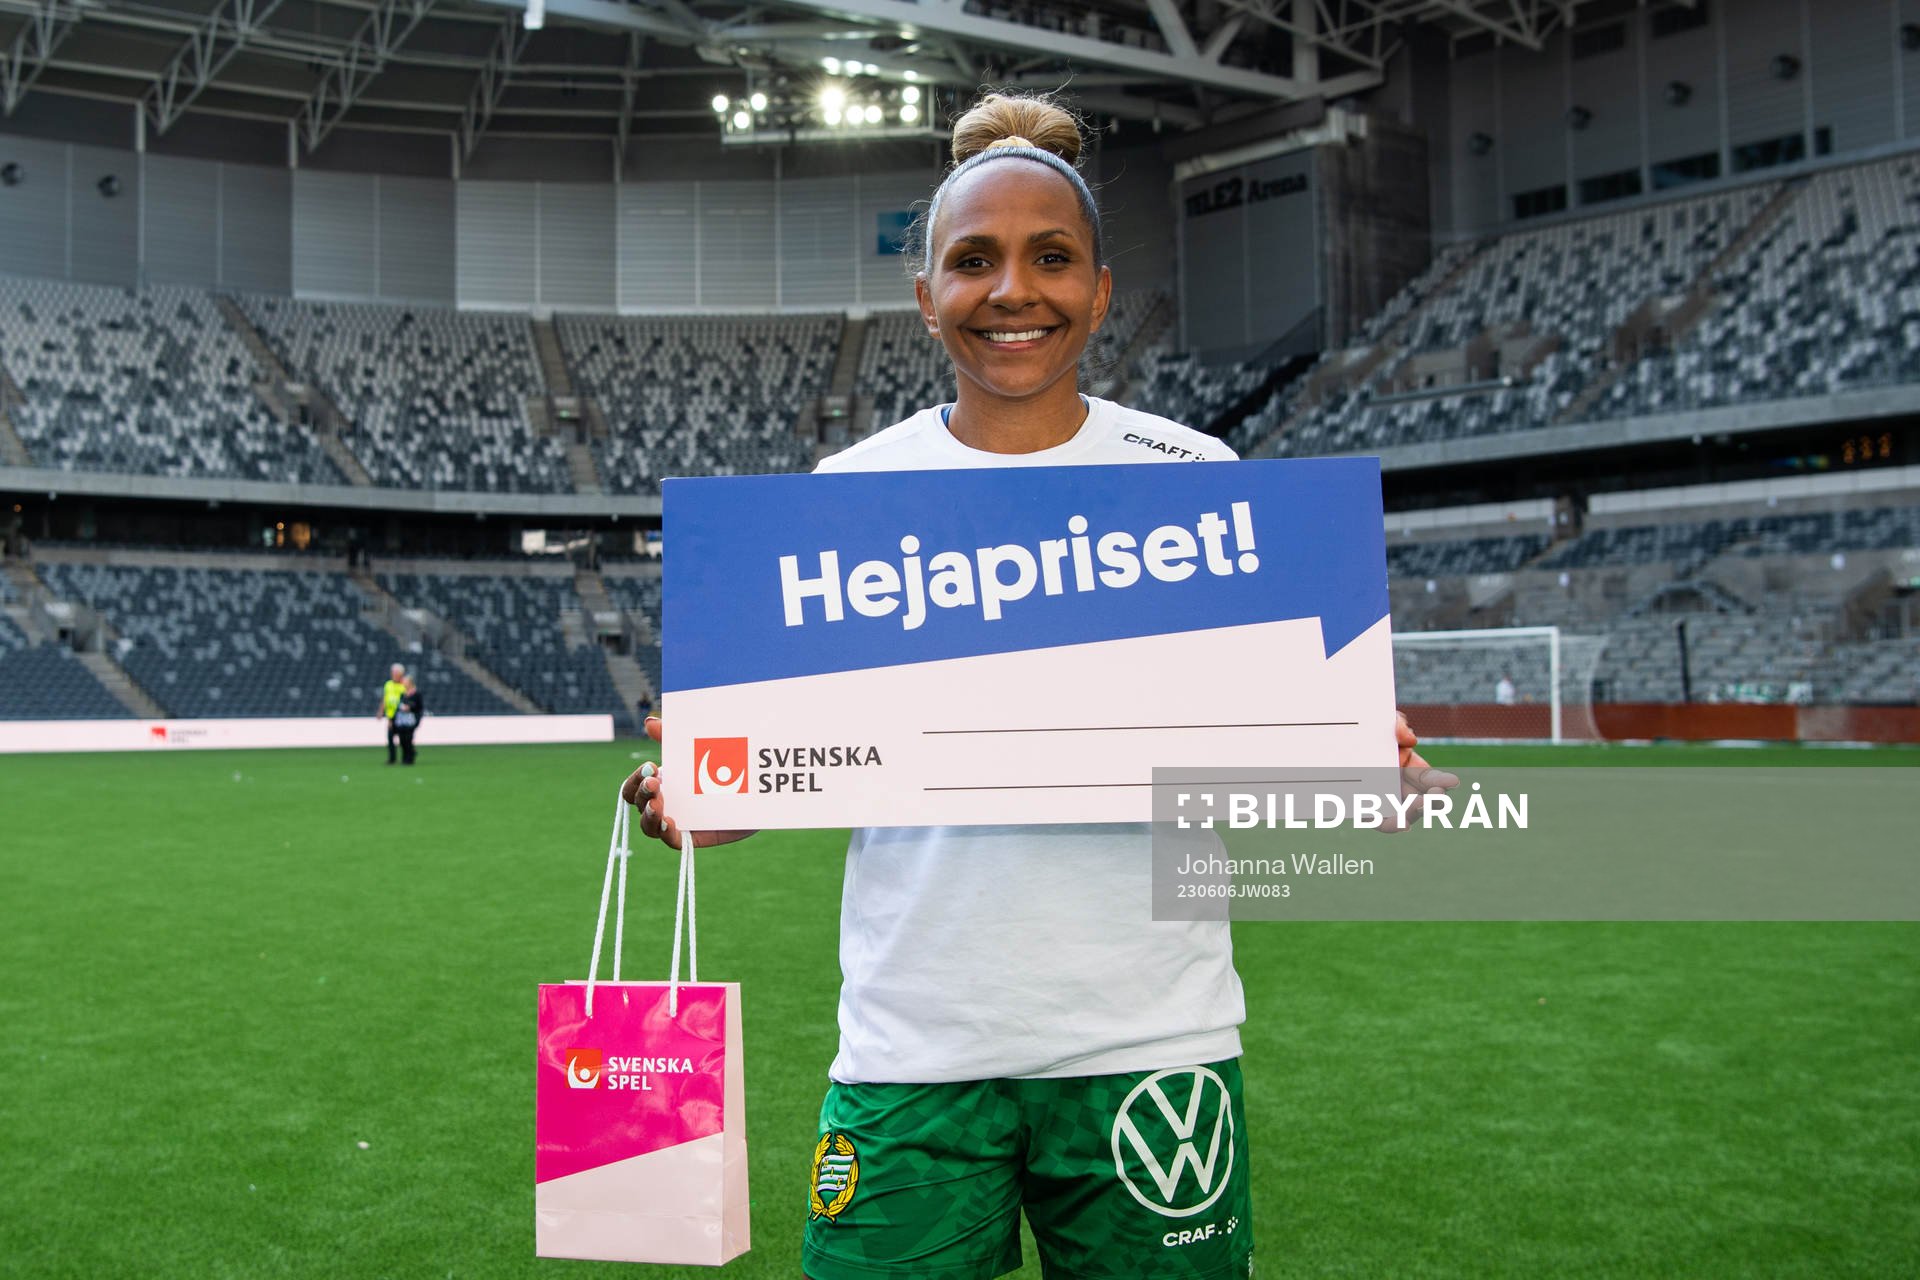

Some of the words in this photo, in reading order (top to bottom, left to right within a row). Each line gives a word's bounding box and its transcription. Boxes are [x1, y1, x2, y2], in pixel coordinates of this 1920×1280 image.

[1247, 173, 1308, 204] Arena
[1123, 433, 1192, 459] CRAFT
[779, 501, 1260, 630] Hejapriset!
[758, 746, 882, 768] SVENSKA
[758, 773, 823, 793] SPEL
[607, 1057, 694, 1073] SVENSKA
[607, 1075, 652, 1090] SPEL
[1162, 1223, 1223, 1247] CRAF
